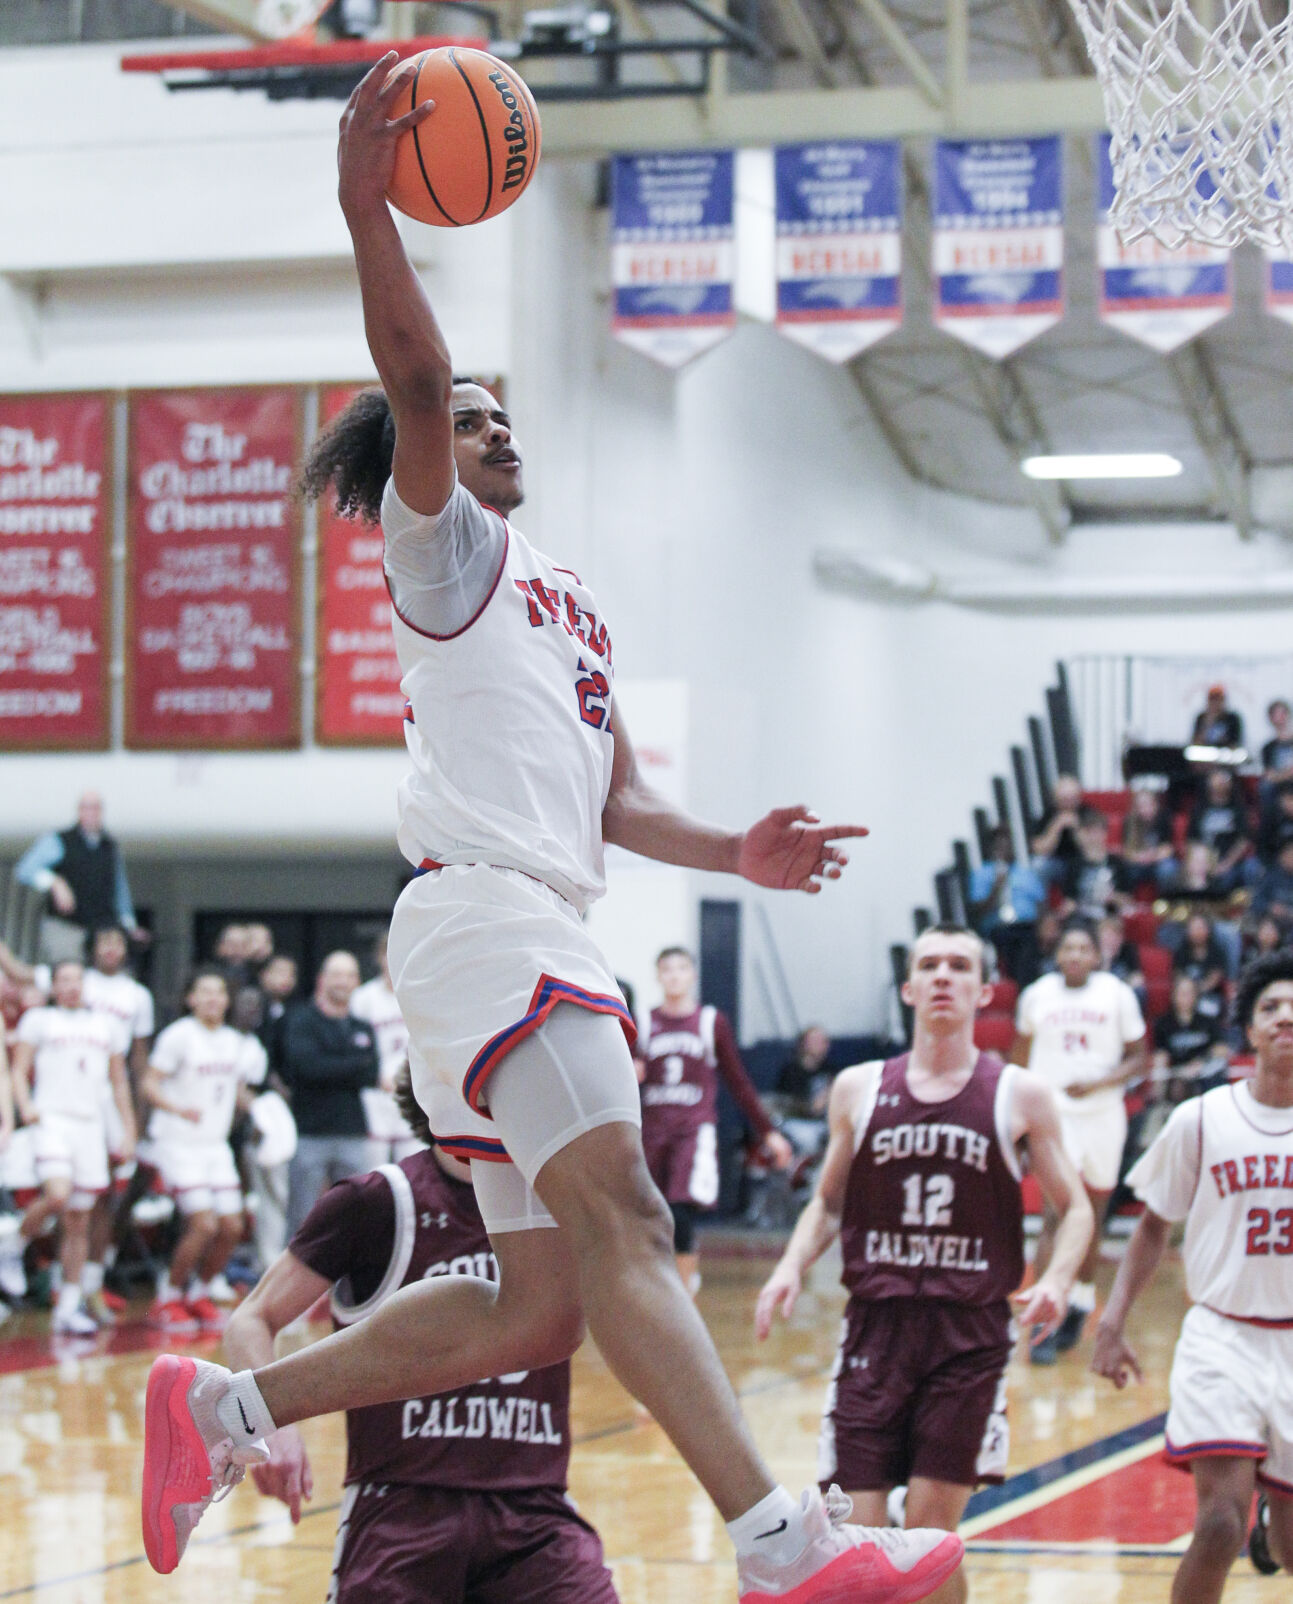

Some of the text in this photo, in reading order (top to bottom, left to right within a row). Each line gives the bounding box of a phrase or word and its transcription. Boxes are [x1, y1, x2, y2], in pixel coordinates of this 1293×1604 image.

[488, 68, 528, 193] Wilson
[182, 421, 247, 463] The
[871, 1123, 991, 1174] SOUTH
[901, 1173, 955, 1227] 12
[865, 1230, 989, 1271] CALDWELL
[1246, 1207, 1293, 1256] 23
[402, 1396, 562, 1446] CALDWELL
